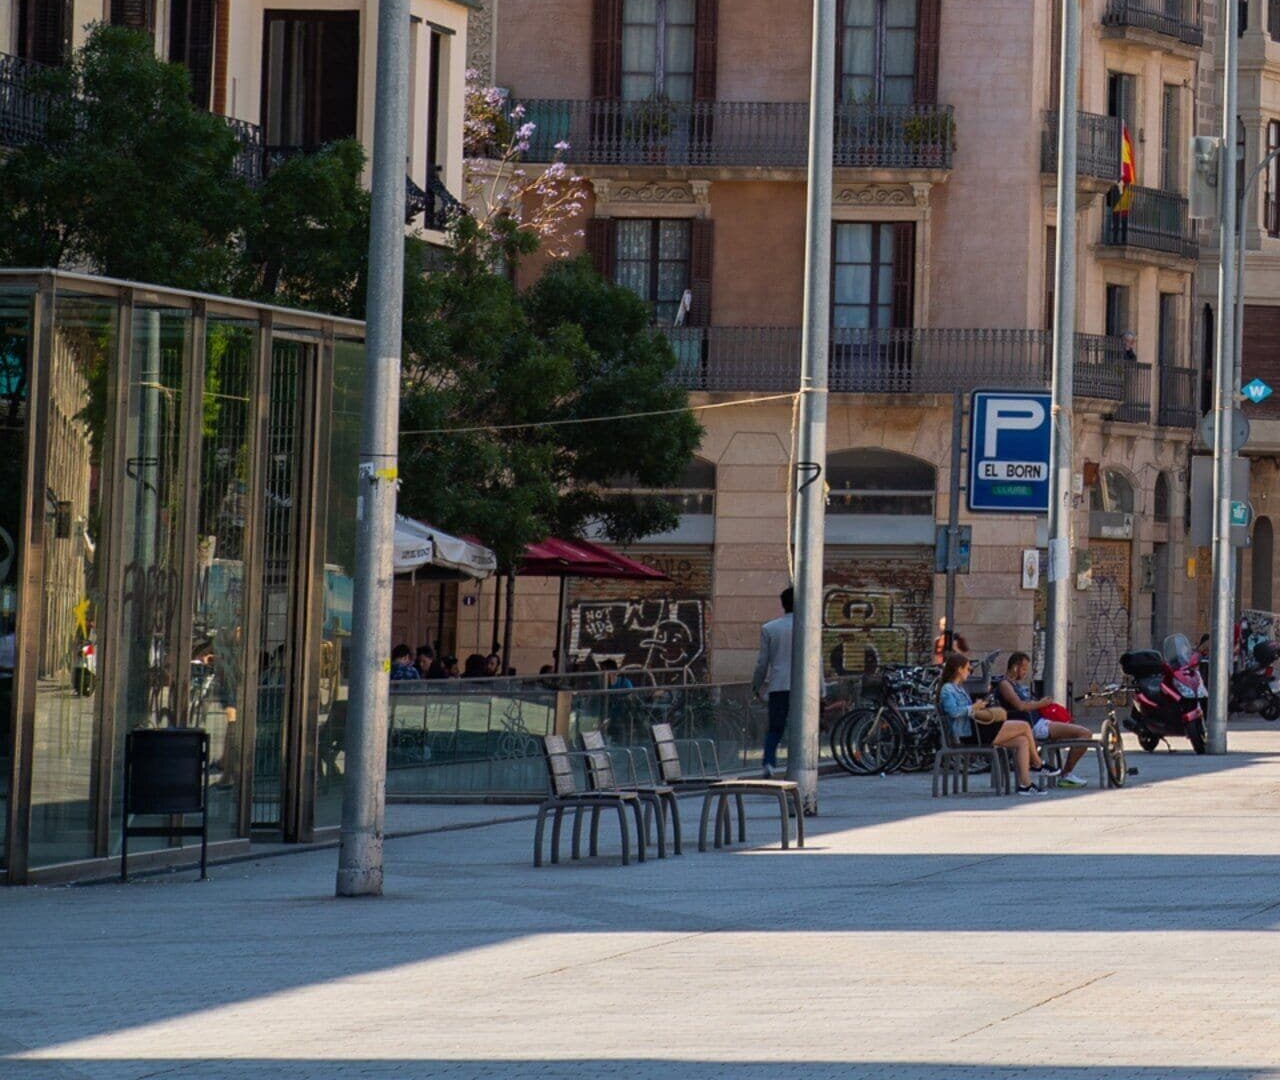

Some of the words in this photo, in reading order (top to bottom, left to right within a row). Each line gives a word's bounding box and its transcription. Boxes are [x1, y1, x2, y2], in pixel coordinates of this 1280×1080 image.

[1249, 386, 1265, 396] W
[984, 399, 1045, 457] P
[984, 463, 998, 477] EL
[1006, 464, 1041, 478] BORN
